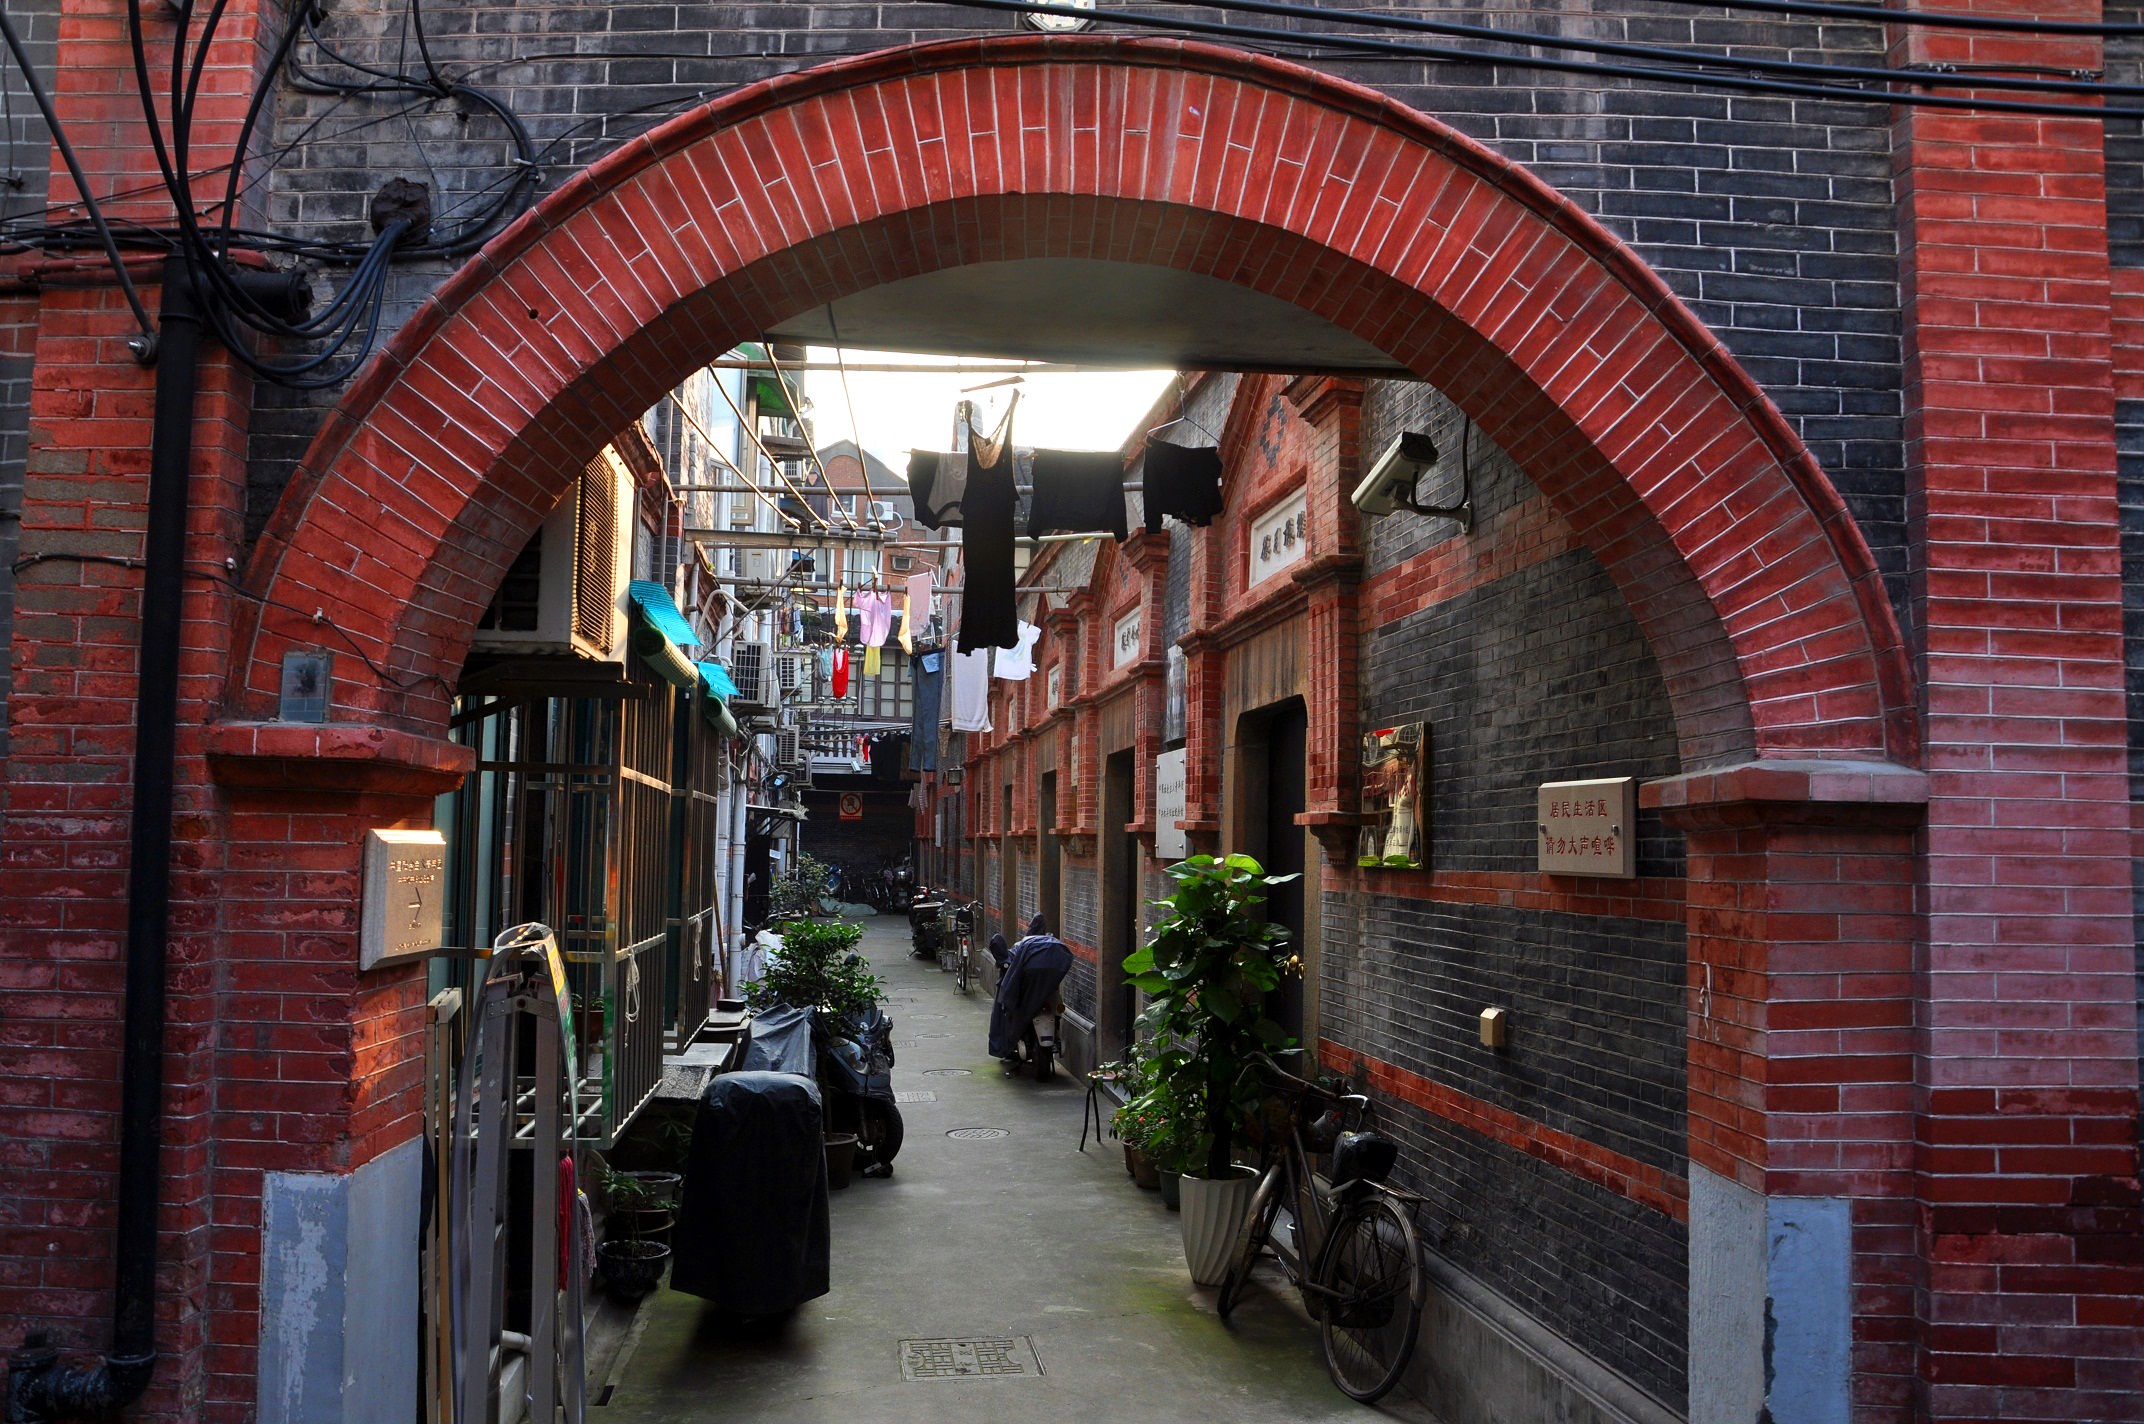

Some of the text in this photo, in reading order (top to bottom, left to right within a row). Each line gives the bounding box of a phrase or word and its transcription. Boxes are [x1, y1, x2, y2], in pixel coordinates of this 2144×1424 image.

[1549, 799, 1608, 819] 居民生活区
[1545, 835, 1616, 857] 请勿大声喧哗
